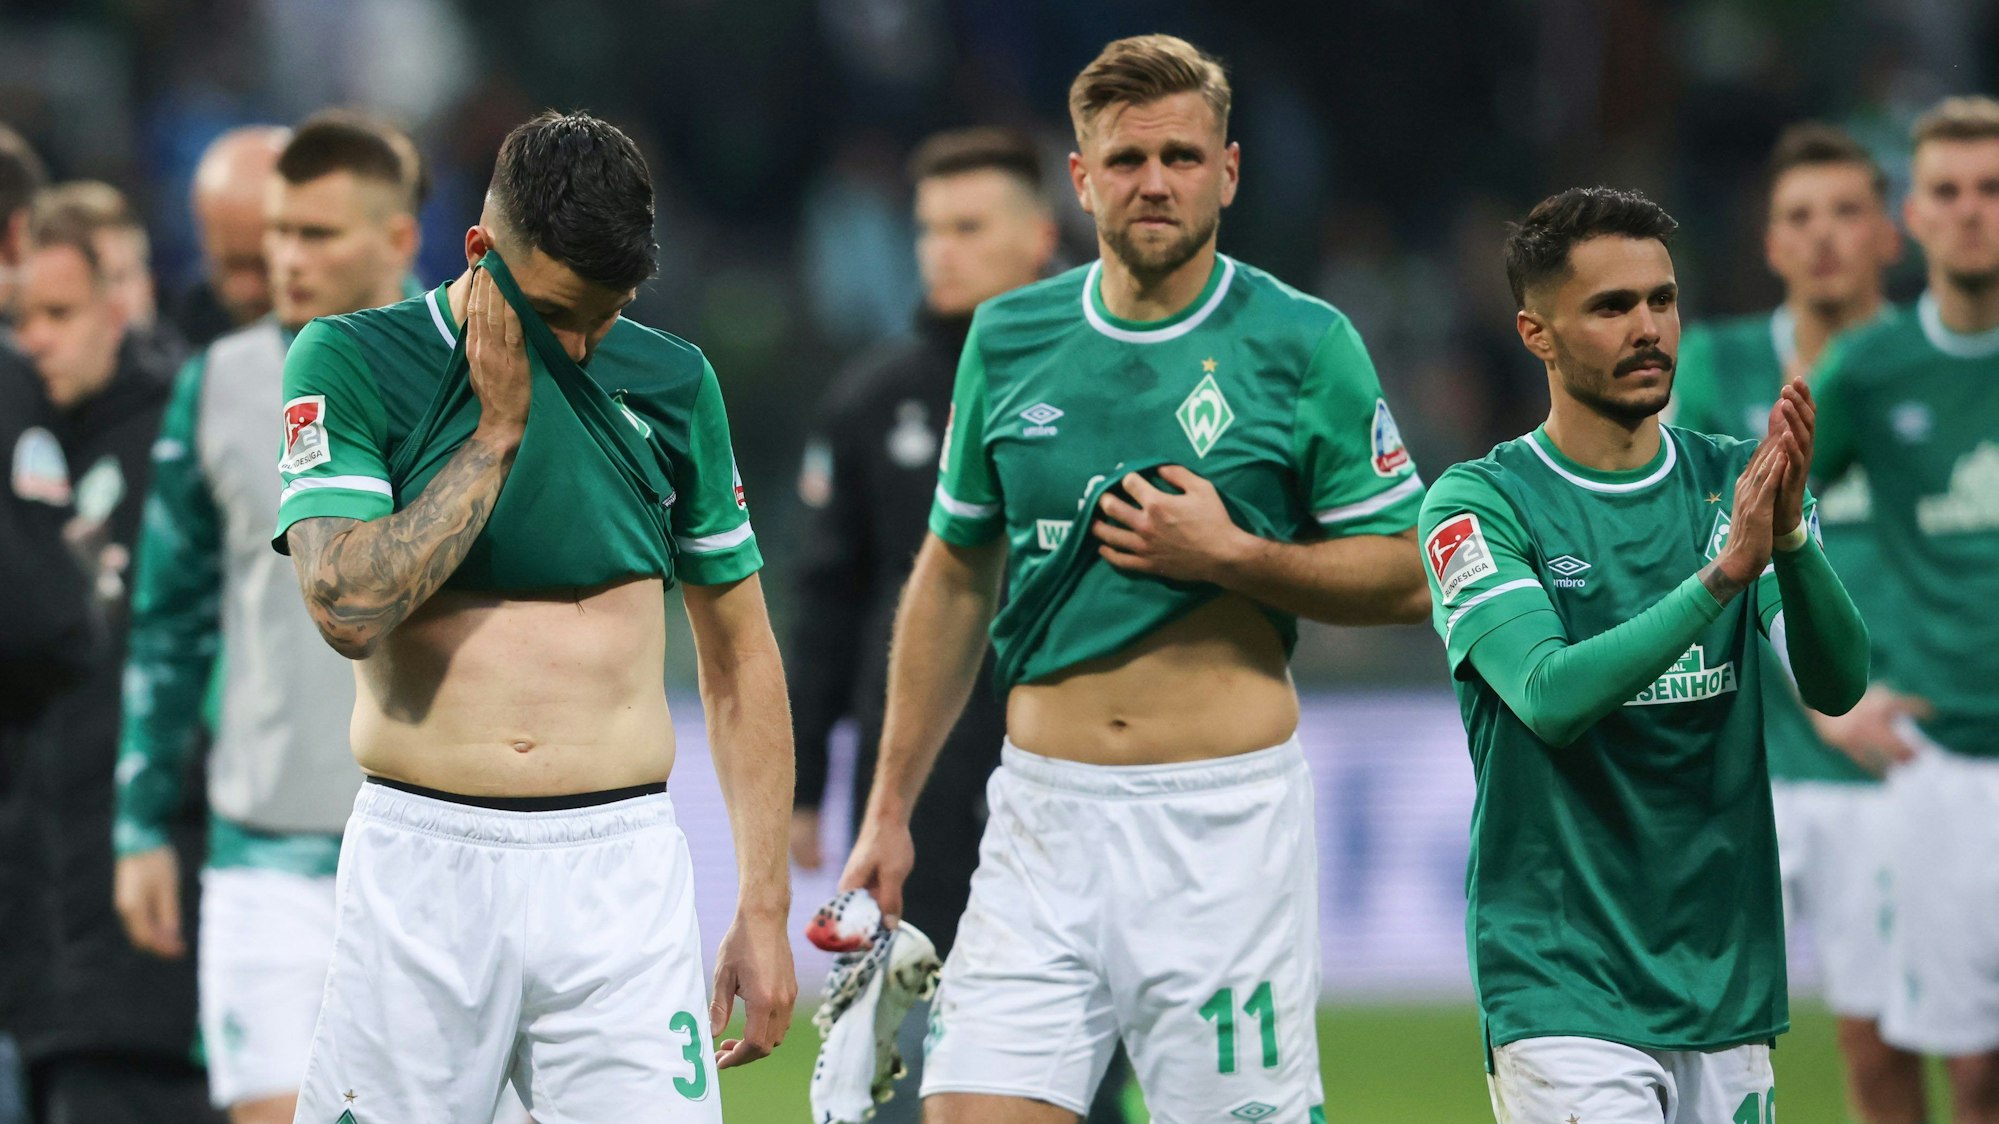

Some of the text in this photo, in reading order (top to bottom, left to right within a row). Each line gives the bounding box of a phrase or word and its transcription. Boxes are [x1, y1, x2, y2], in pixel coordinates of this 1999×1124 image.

[1445, 562, 1488, 598] BUNDESLIGA
[1463, 540, 1478, 561] 2
[669, 1010, 708, 1101] 3
[1198, 981, 1278, 1073] 11
